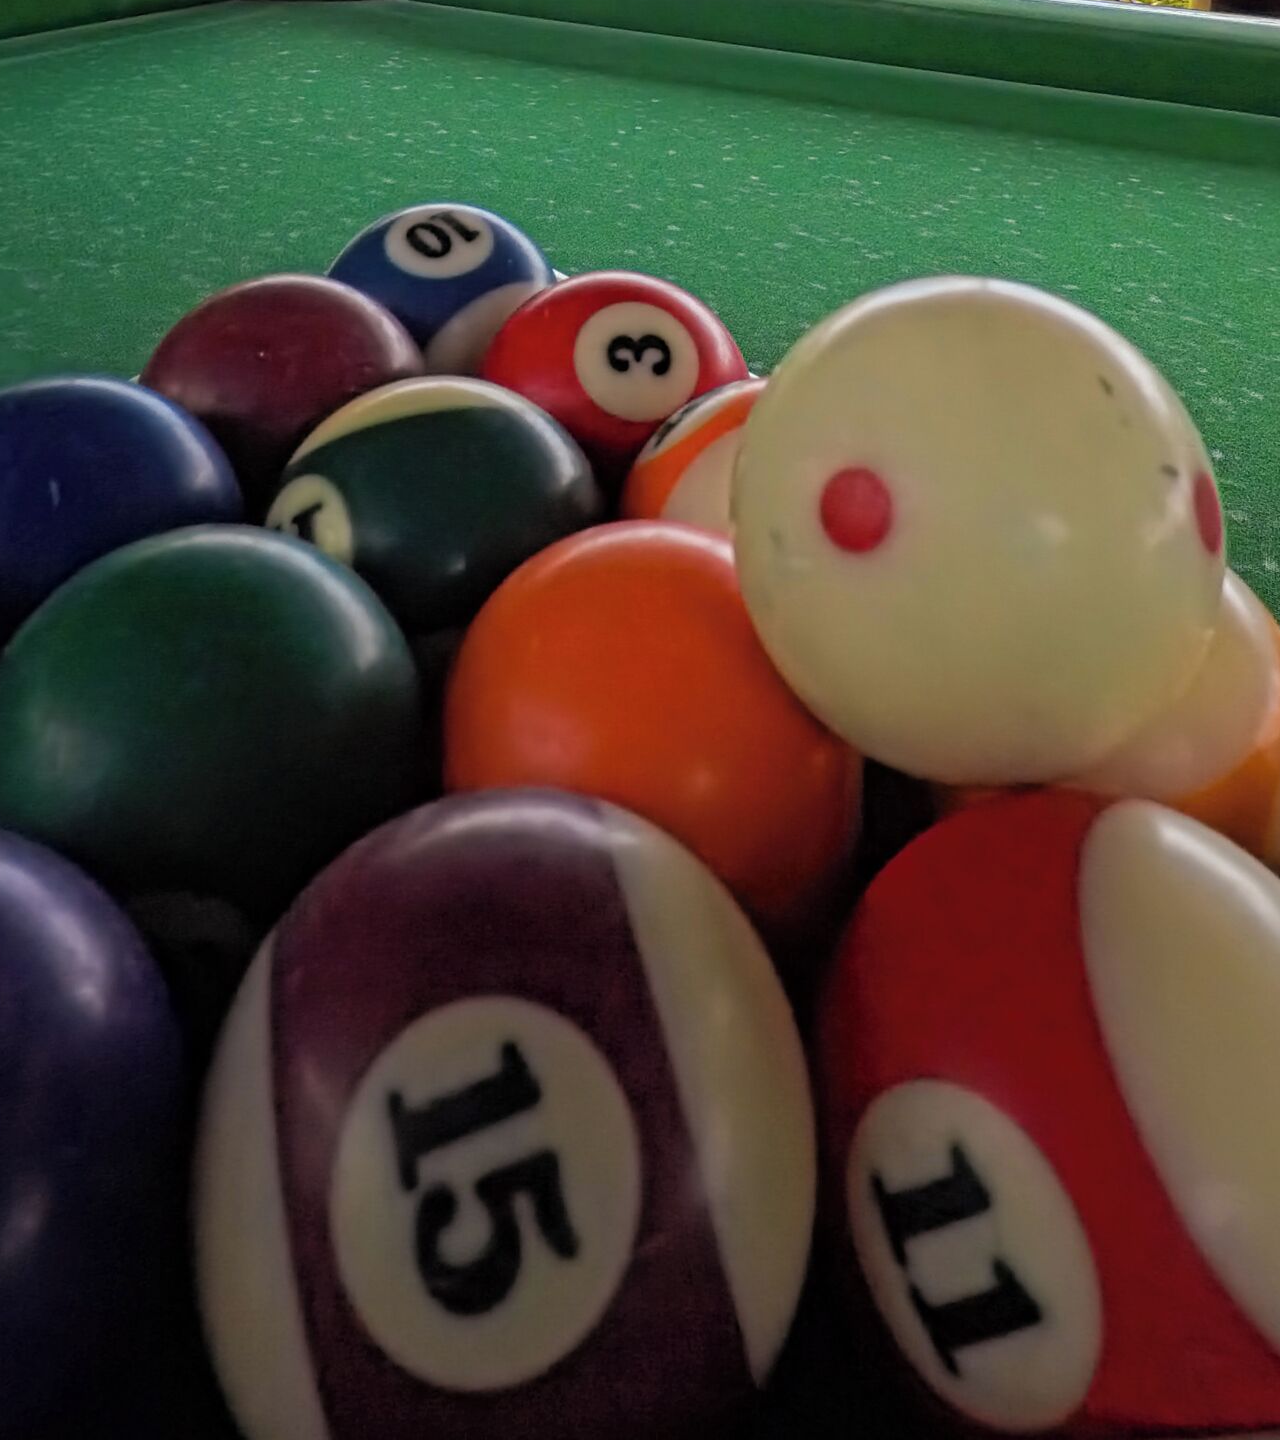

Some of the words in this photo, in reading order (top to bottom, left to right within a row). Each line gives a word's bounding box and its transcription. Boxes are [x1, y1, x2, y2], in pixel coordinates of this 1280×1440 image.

[405, 210, 480, 259] 10
[607, 334, 671, 377] 3
[387, 1041, 579, 1315] 15
[869, 1142, 1043, 1379] 11
